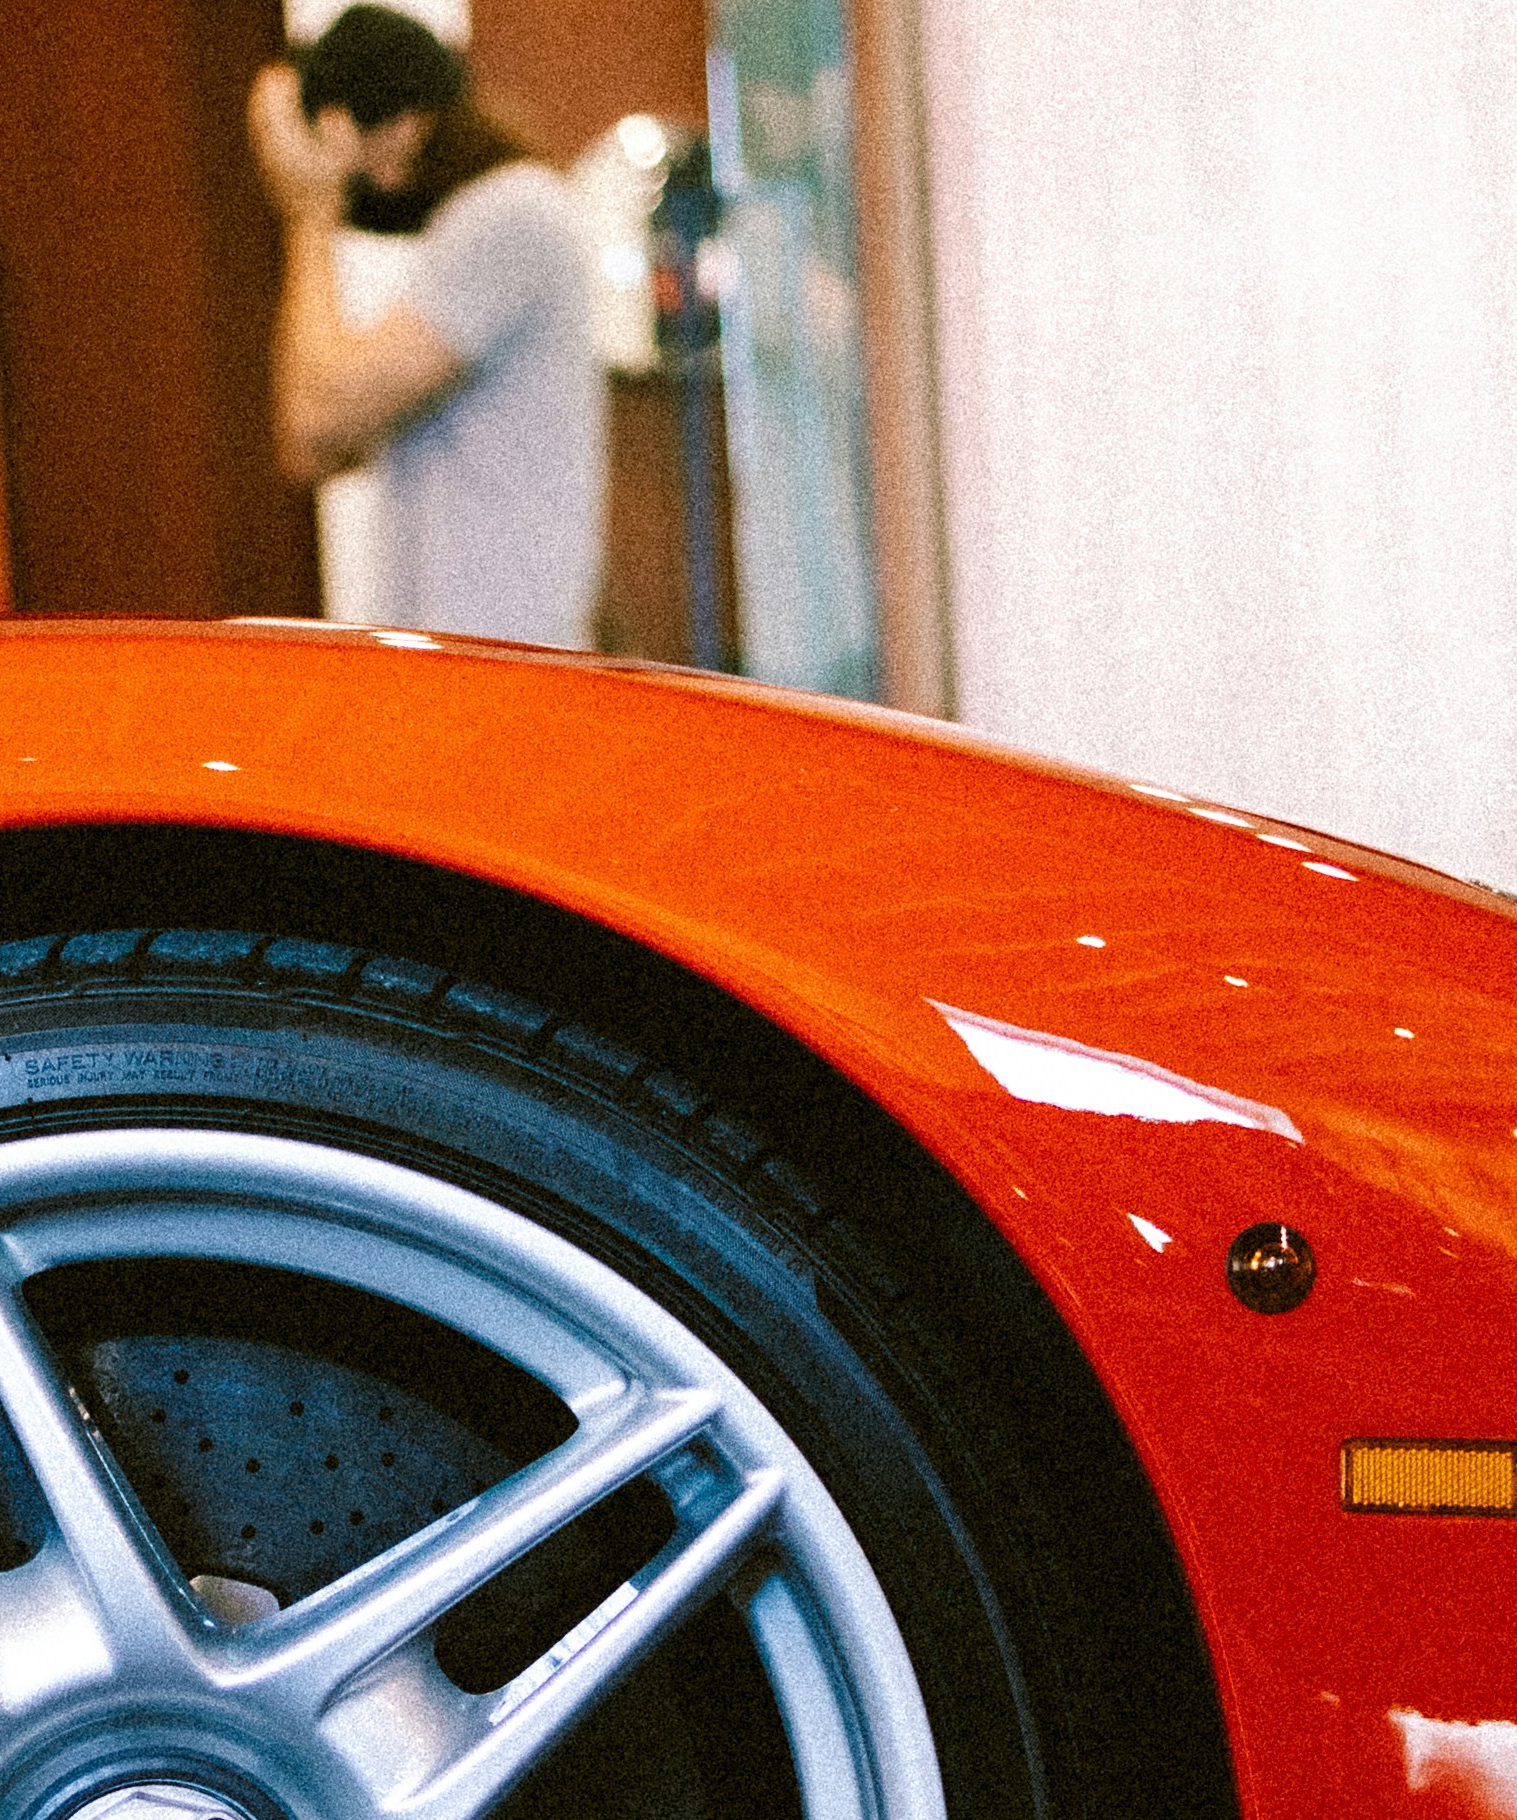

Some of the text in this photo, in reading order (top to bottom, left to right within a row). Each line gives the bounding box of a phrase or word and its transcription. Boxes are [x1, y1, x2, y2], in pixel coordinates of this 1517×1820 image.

[25, 1049, 227, 1075] SAFETY WARNING
[27, 1075, 71, 1089] SERIOUS
